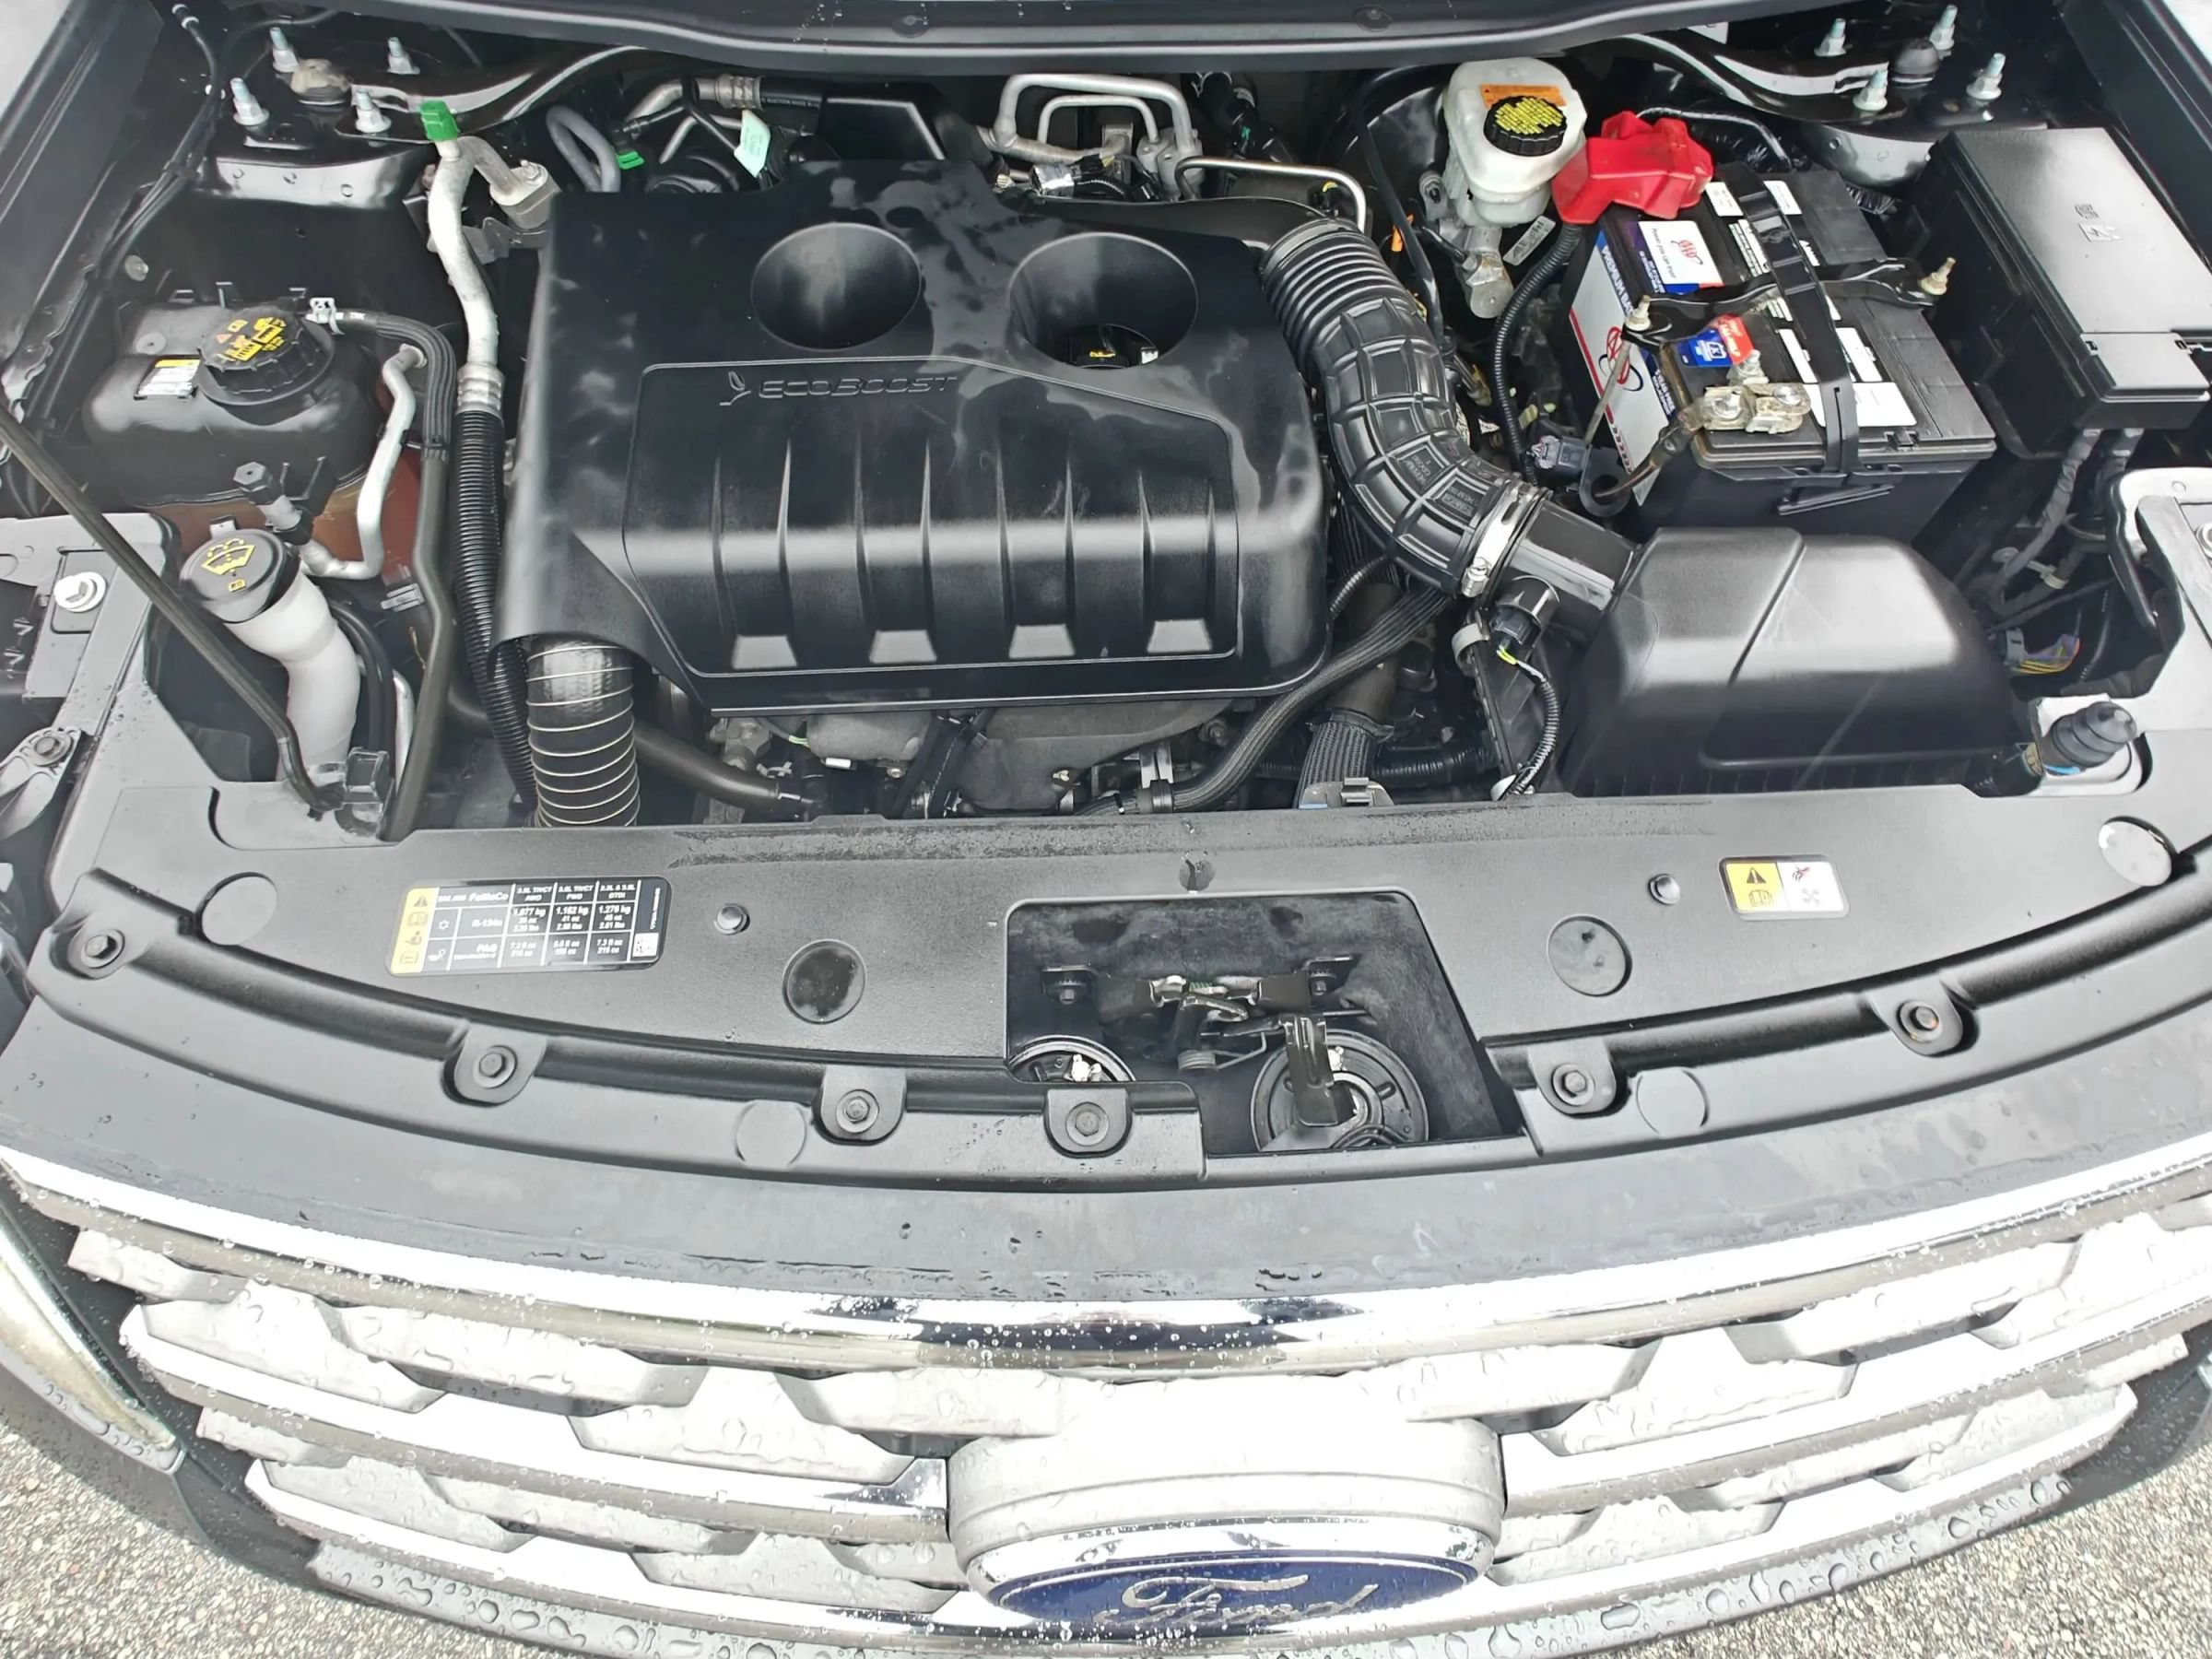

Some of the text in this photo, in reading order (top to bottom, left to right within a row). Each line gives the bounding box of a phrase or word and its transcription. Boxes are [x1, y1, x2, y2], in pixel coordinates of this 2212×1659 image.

[1602, 244, 1628, 296] PREMIUM
[759, 376, 959, 399] ECOBOOST
[1091, 1574, 1380, 1625] Ford
